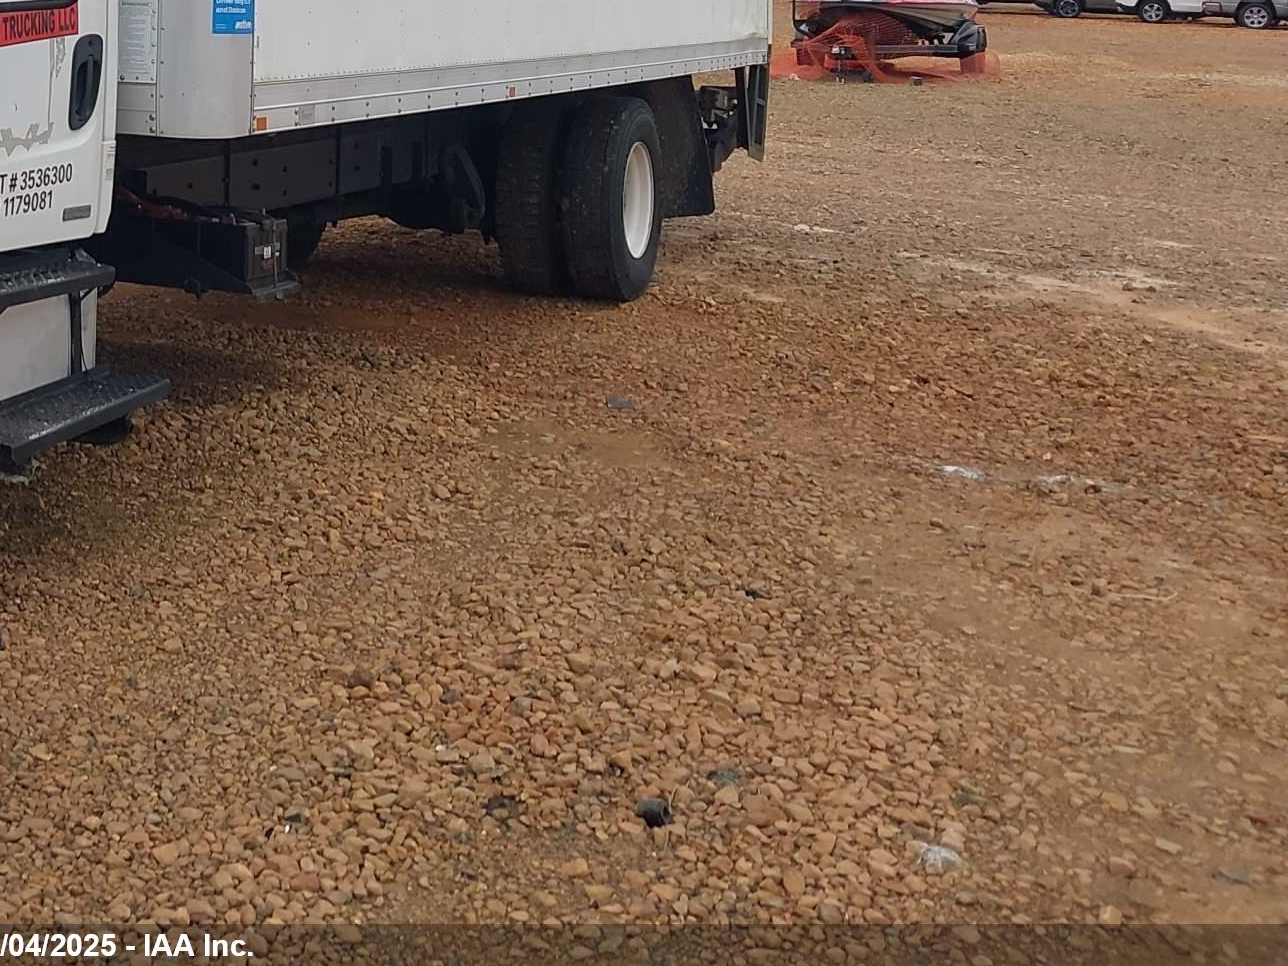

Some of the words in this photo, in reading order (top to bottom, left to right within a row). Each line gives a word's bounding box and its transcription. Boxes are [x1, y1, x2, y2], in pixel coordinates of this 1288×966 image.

[2, 10, 56, 41] TRUCKING
[58, 7, 76, 31] LLC
[9, 172, 18, 193] #
[20, 163, 73, 191] 3536300
[3, 190, 53, 217] 1179081
